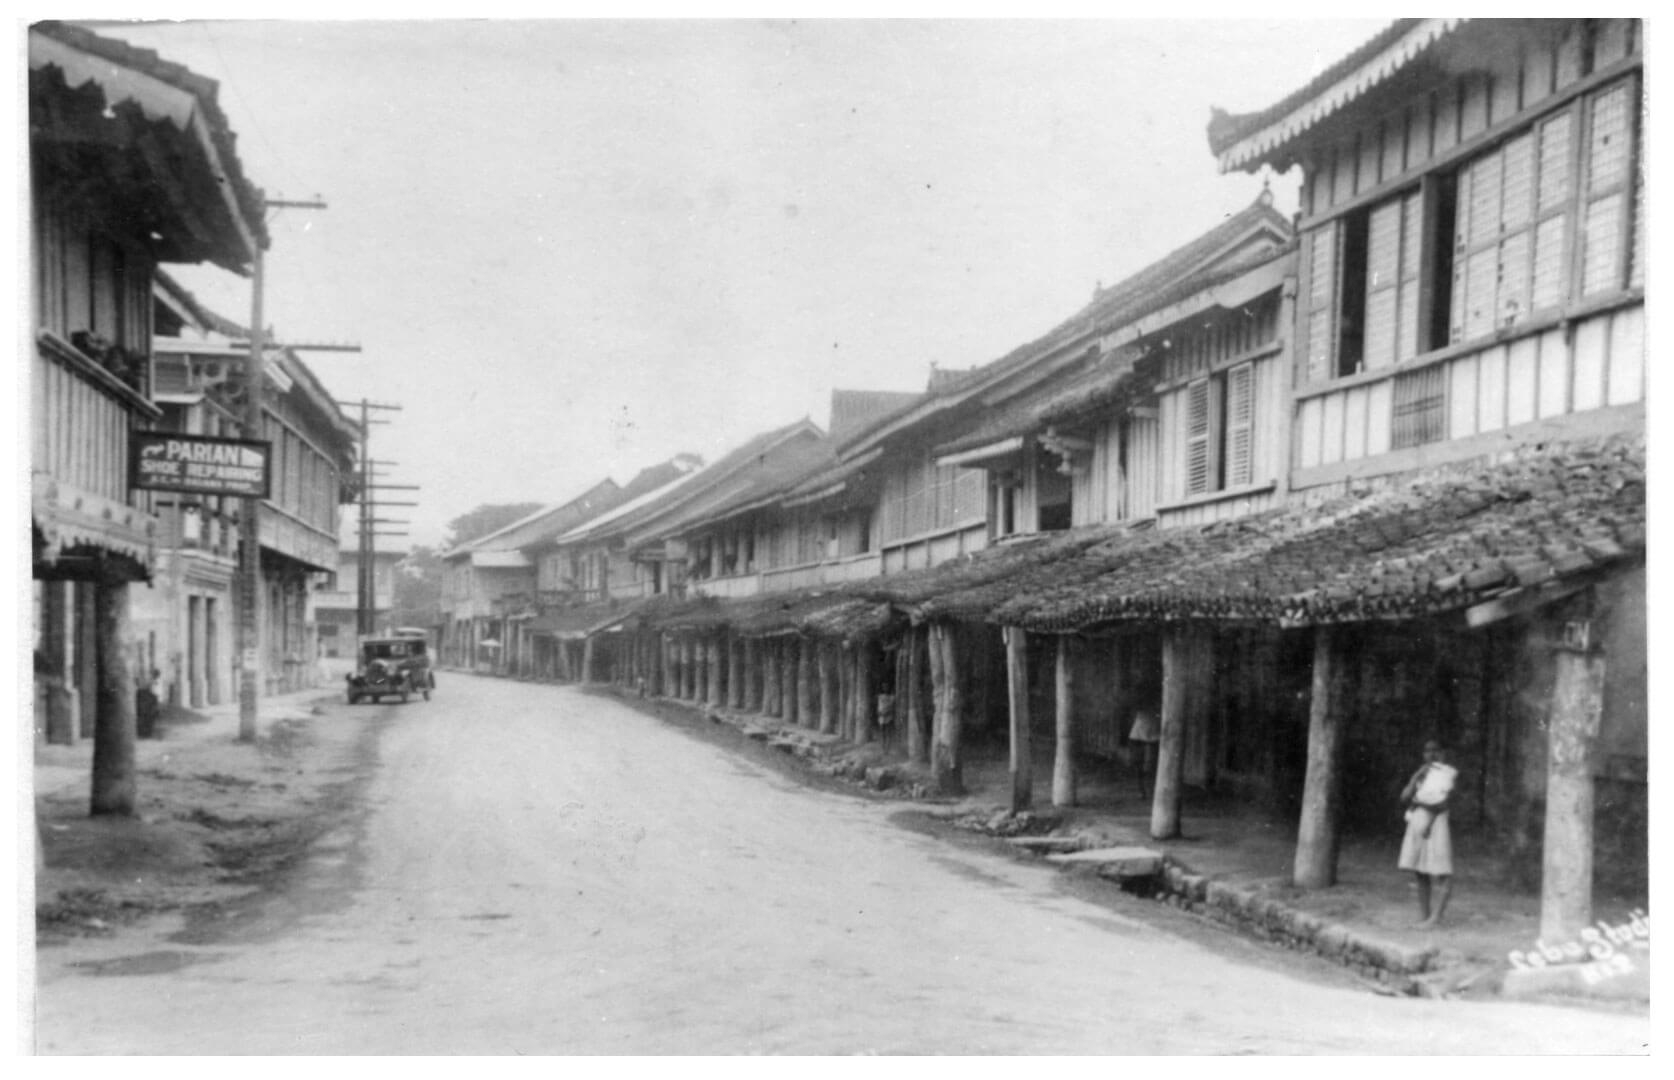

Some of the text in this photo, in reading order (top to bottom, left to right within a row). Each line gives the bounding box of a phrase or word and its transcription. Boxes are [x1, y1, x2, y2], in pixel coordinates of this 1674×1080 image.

[166, 440, 239, 465] PARIAN
[140, 459, 180, 475] SHOE
[186, 463, 263, 482] REPAIRING
